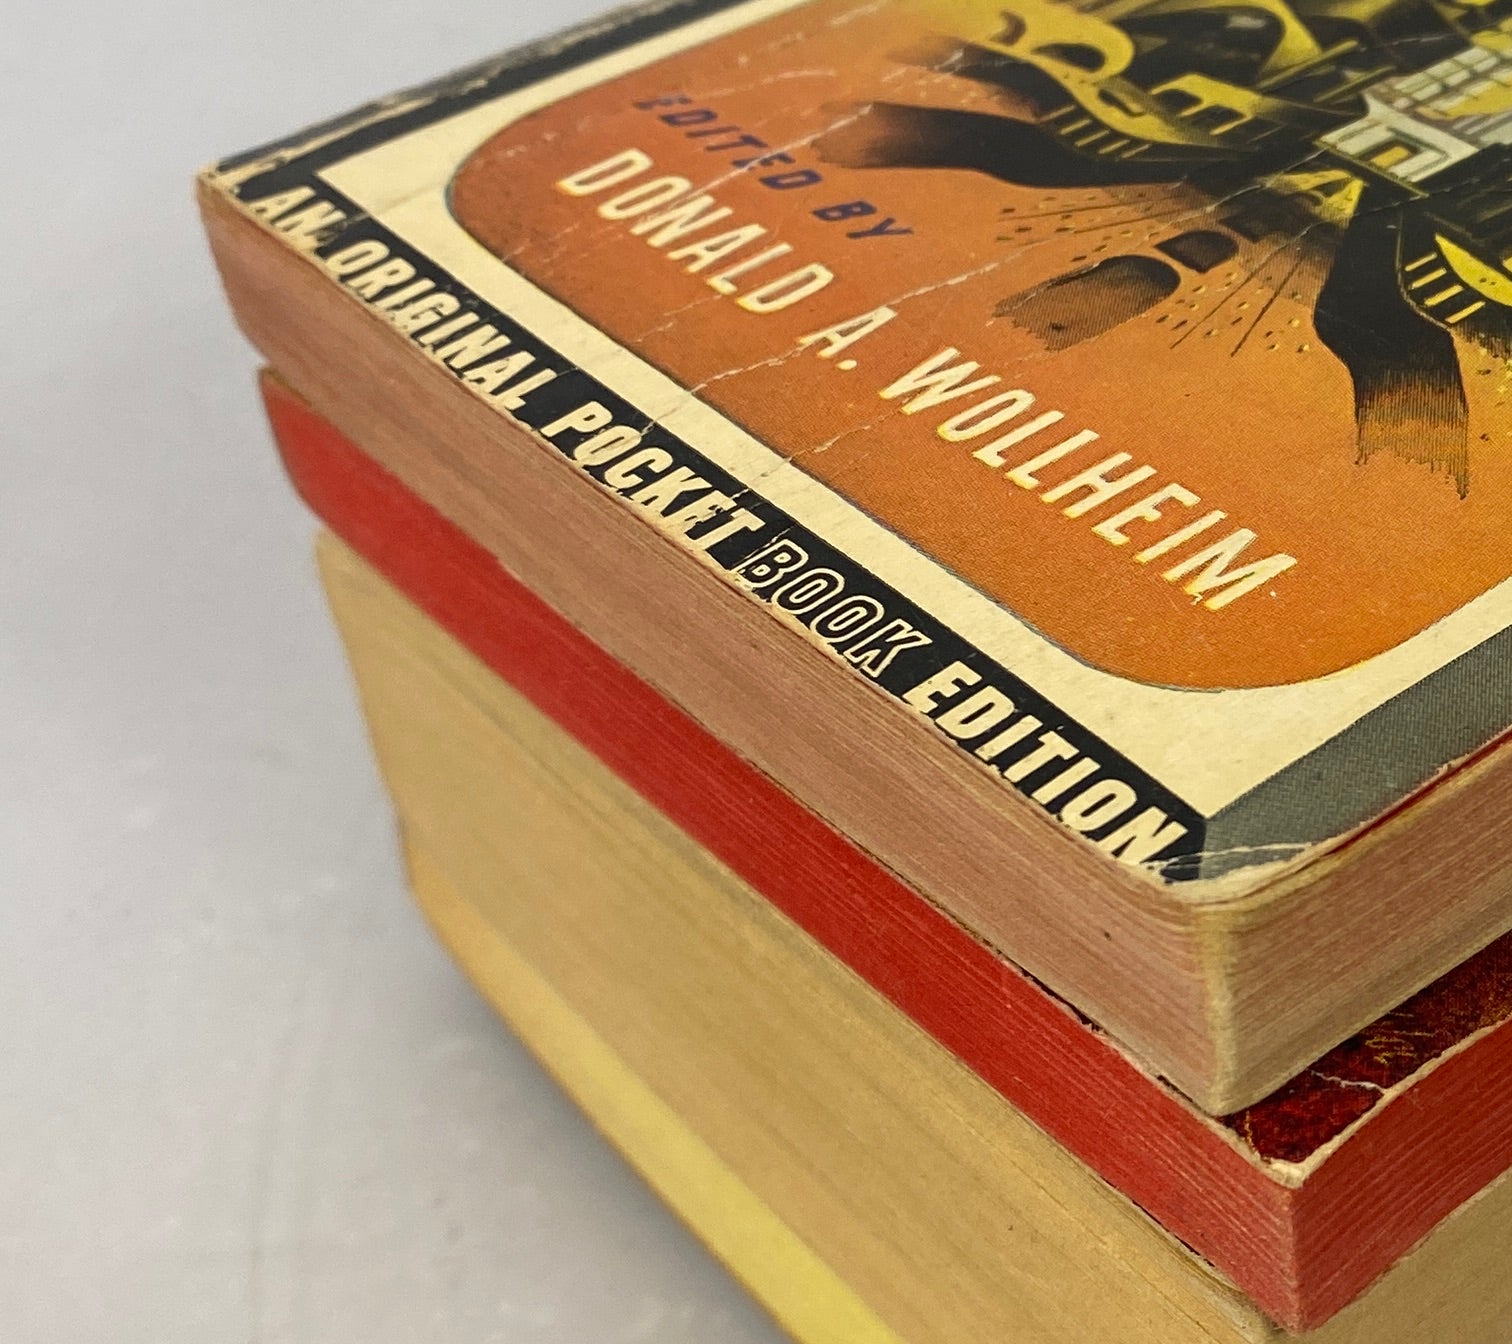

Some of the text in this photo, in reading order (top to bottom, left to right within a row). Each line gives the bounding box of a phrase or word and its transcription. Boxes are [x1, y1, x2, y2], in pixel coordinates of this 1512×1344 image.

[556, 147, 1299, 612] DONALD A. WOLLHEIM
[632, 93, 914, 241] EDITED BY
[250, 185, 1189, 871] AN ORIGINAL POCKET BOOK EDITION
